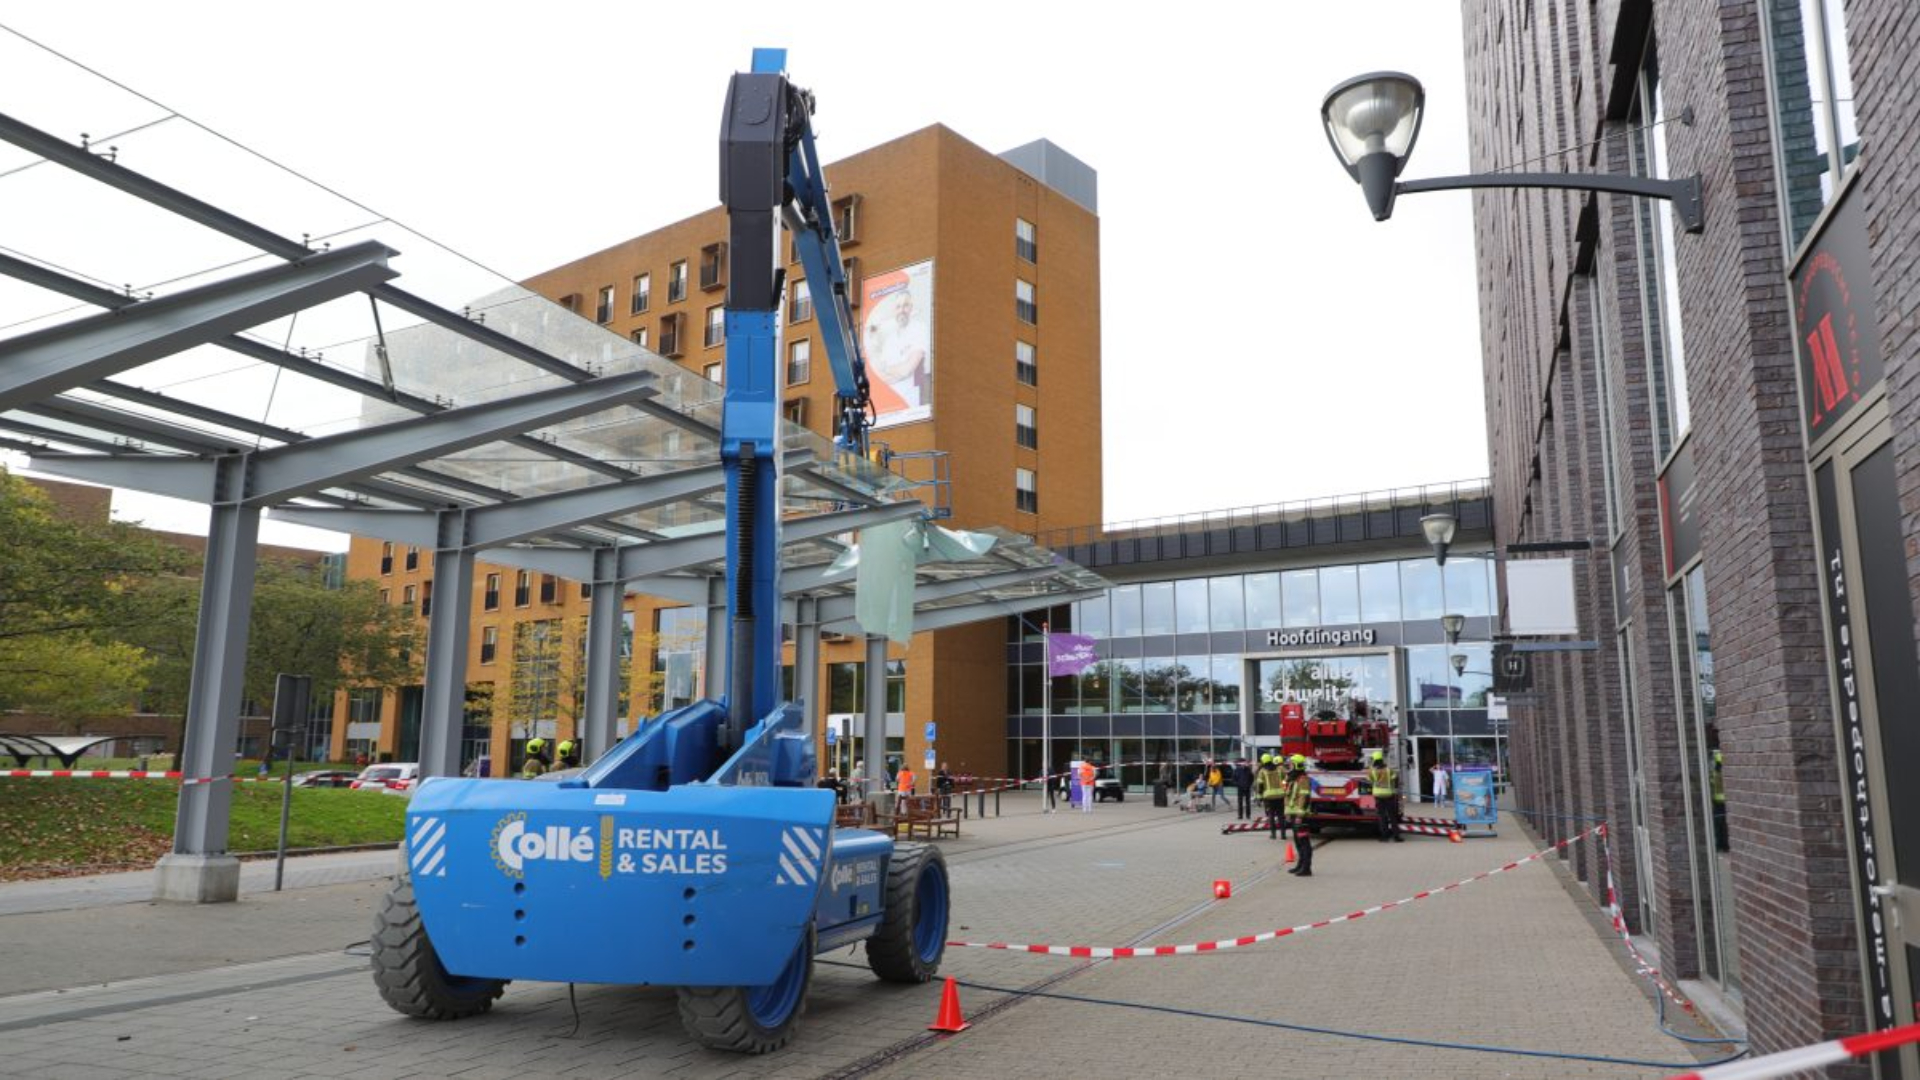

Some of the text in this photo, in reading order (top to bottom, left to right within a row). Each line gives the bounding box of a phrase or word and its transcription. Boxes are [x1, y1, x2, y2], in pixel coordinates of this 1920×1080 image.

[1267, 629, 1374, 645] Hoofdingang
[498, 820, 594, 871] Collé
[618, 828, 727, 850] RENTAL
[617, 853, 727, 874] & SALES
